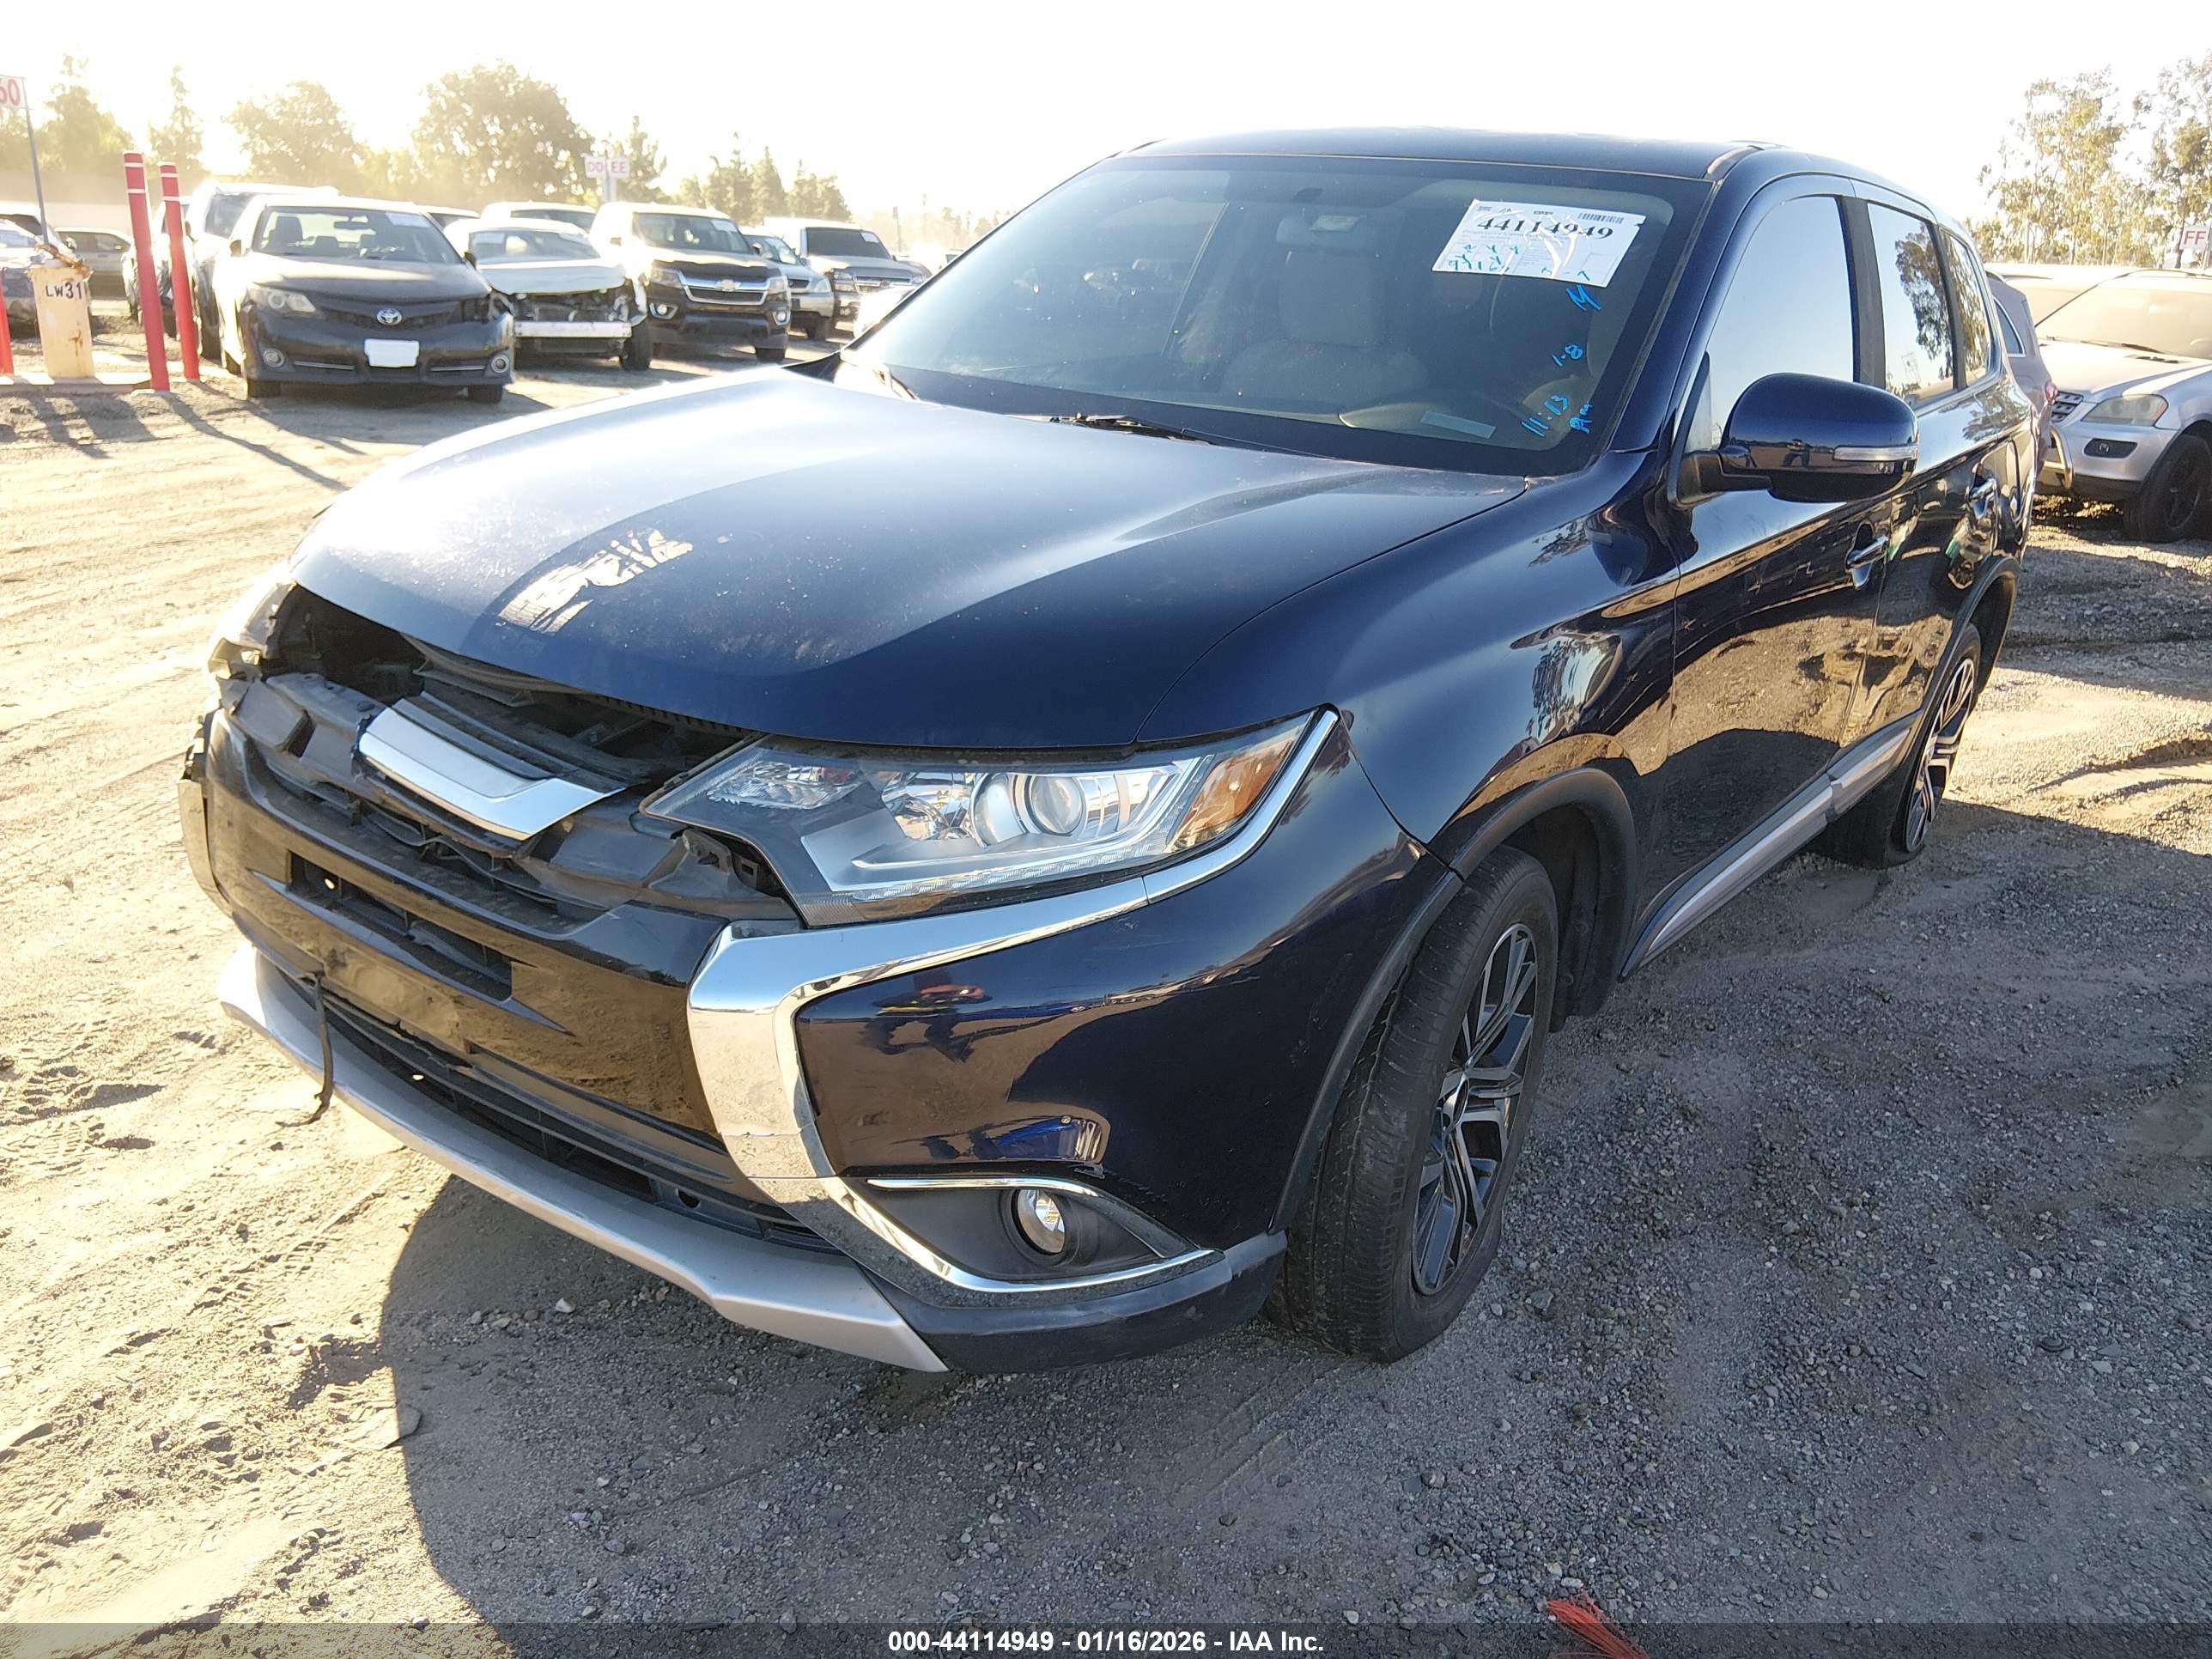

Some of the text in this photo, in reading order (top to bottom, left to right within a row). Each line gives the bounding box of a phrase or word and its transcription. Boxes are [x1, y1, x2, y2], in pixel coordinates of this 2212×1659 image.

[1477, 218, 1613, 240] 44114949
[2184, 230, 2206, 245] FF
[46, 282, 82, 300] LW31
